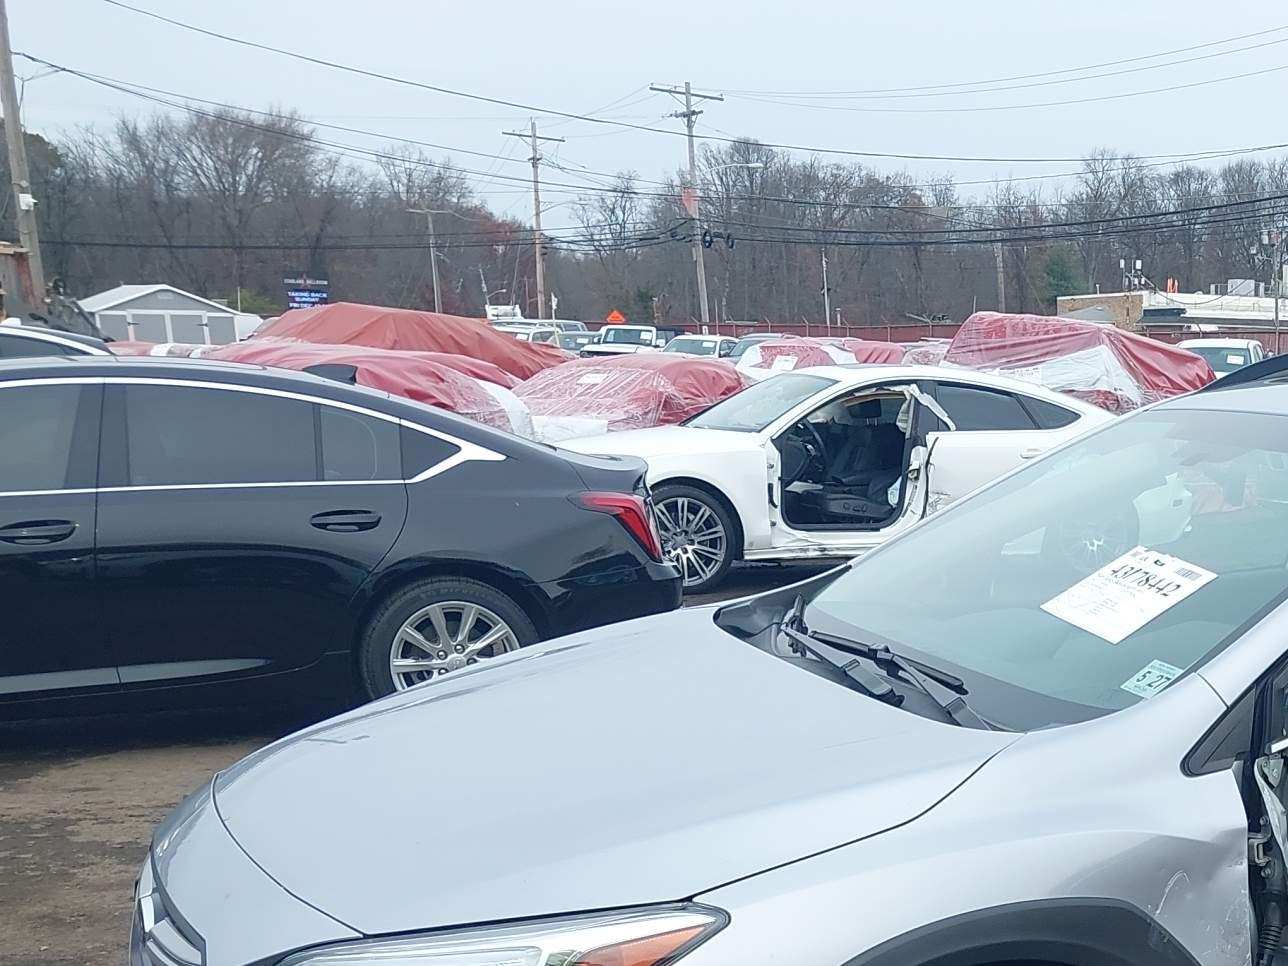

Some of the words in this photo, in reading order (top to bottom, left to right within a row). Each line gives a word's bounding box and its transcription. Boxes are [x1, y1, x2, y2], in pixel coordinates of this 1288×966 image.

[1111, 564, 1181, 597] 43778442
[1136, 671, 1152, 683] 5
[1146, 674, 1172, 690] 27
